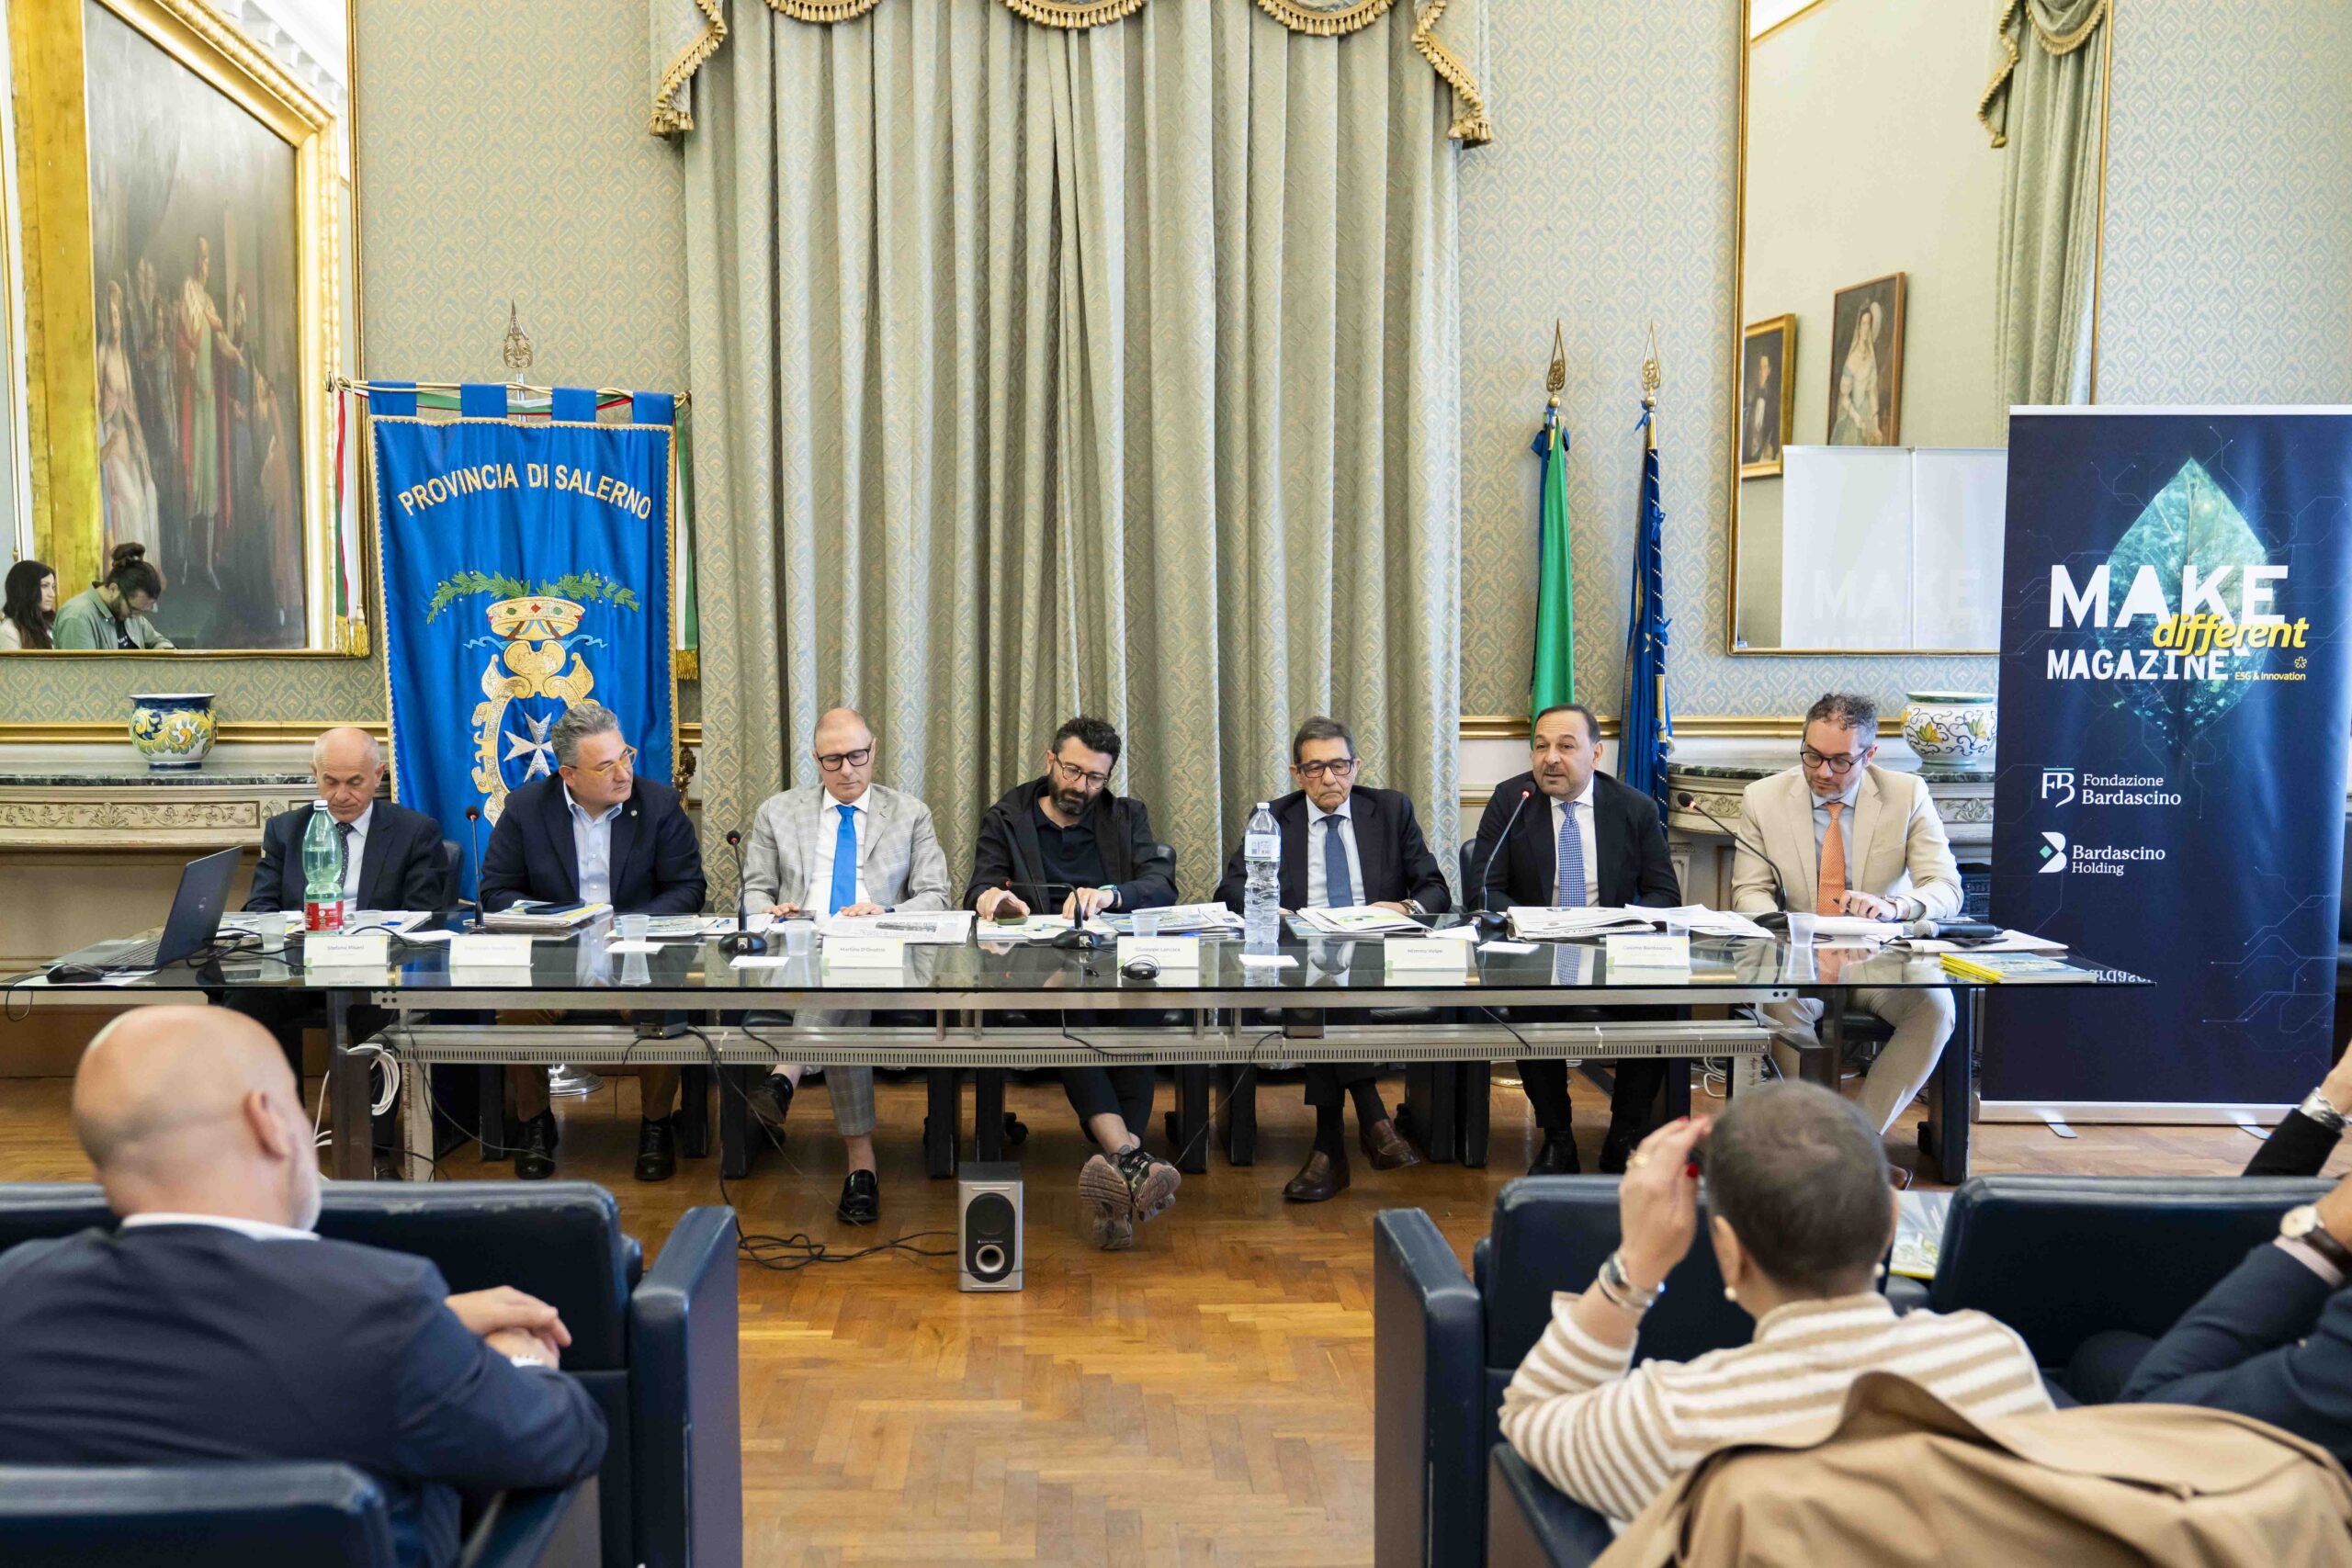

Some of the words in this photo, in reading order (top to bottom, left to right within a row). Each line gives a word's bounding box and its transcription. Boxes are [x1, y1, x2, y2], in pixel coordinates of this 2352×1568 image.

[397, 463, 519, 516] PROVINCIA
[526, 463, 548, 489] DI
[554, 464, 651, 520] SALERNO
[2048, 564, 2289, 656] MAKE
[2152, 613, 2310, 657] different
[2046, 649, 2230, 681] MAGAZINE
[2234, 671, 2252, 681] ESG
[2253, 671, 2260, 681] &
[2261, 671, 2306, 681] Innovation
[2083, 773, 2165, 786] Fondazione
[2082, 788, 2182, 805] Bardascino
[2072, 844, 2166, 860] Bardascino
[2071, 862, 2124, 876] Holding
